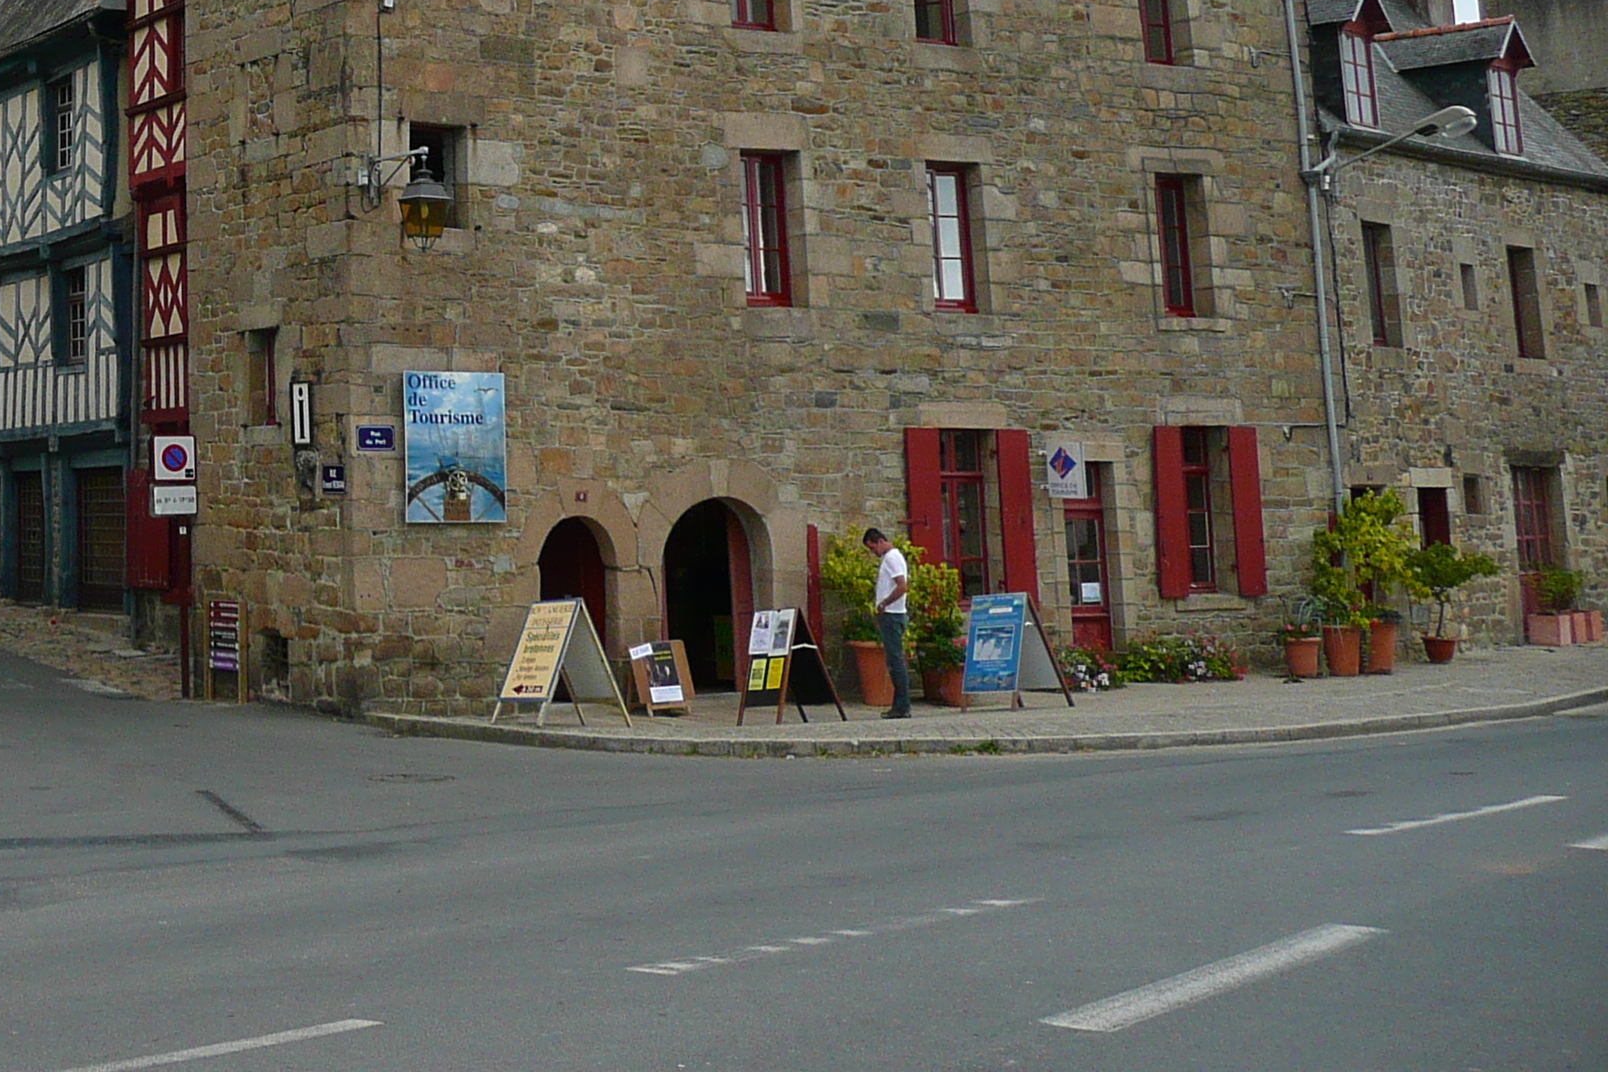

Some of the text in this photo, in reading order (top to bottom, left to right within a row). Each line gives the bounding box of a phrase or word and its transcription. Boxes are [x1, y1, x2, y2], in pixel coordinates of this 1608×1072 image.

[407, 373, 457, 390] Office
[408, 392, 427, 407] de
[409, 409, 484, 425] Tourisme
